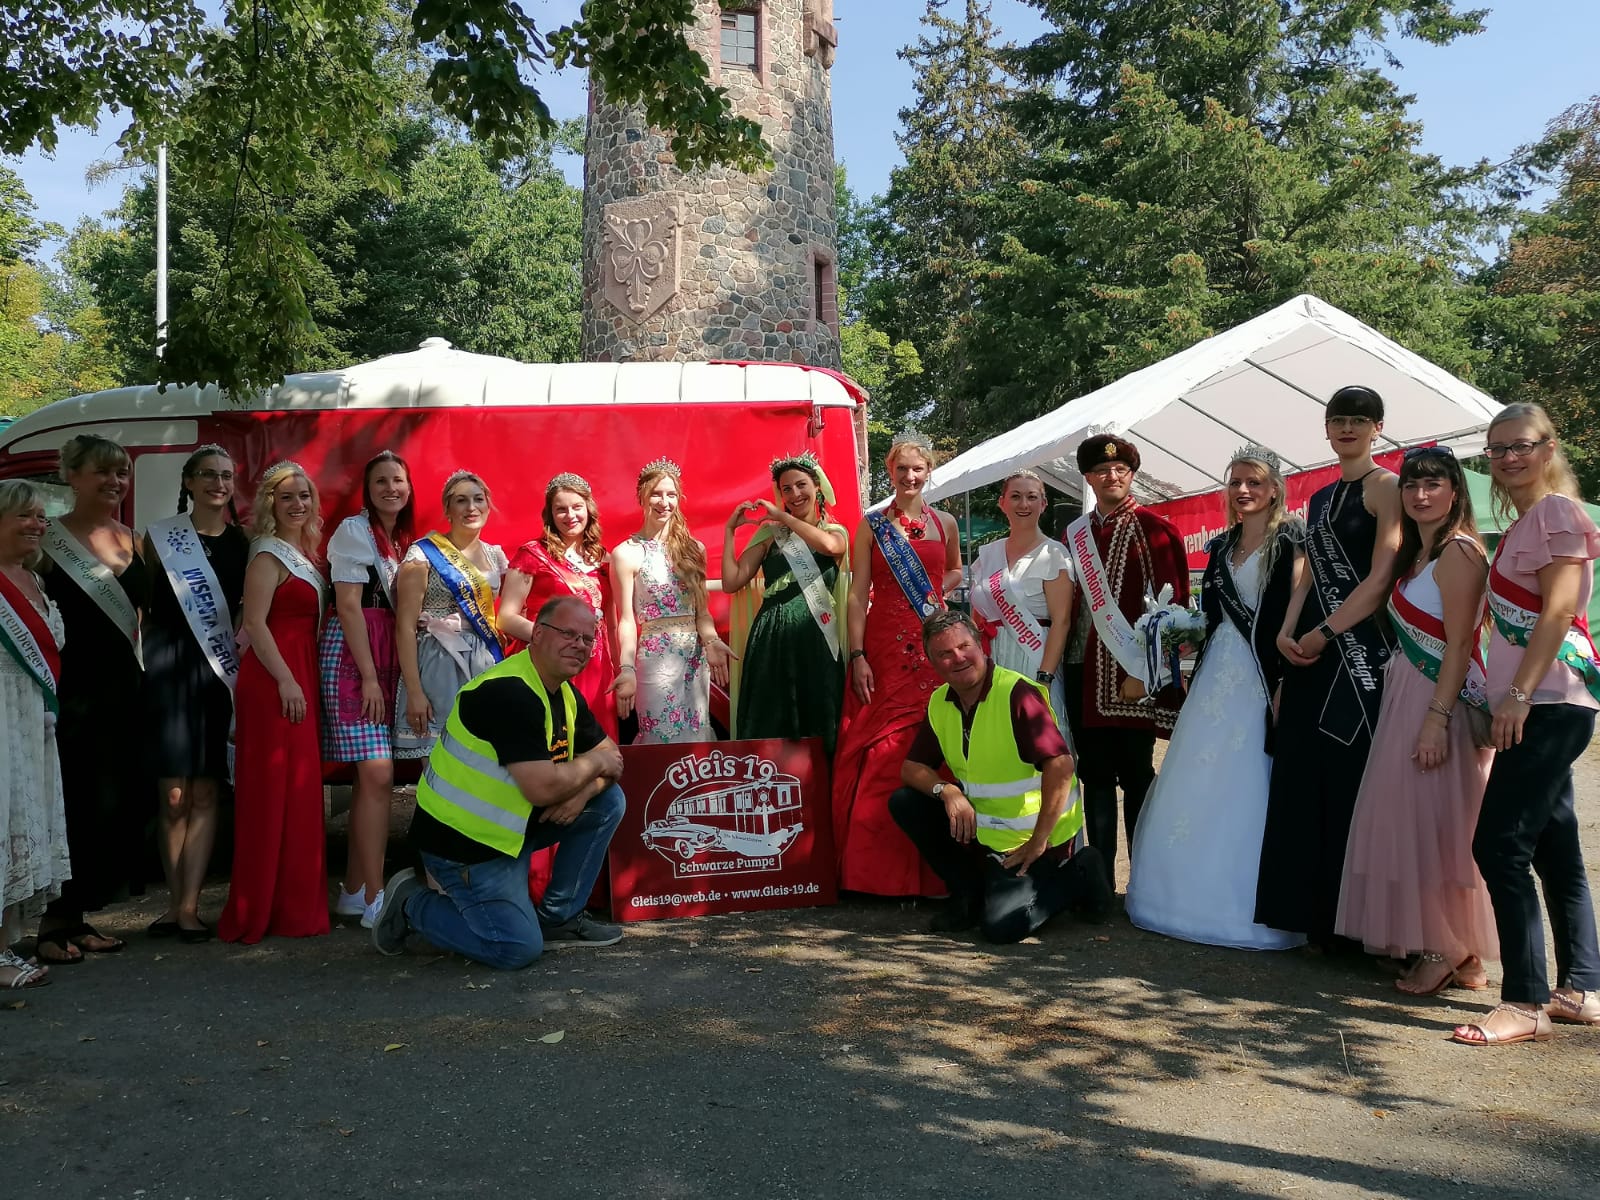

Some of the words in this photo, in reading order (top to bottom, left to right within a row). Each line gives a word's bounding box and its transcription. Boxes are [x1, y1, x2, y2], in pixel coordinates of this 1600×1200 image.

[1073, 525, 1107, 612] Wendenkönig
[1331, 559, 1352, 582] der
[457, 579, 478, 617] Sabrina
[988, 569, 1042, 652] Wendenkönigin
[0, 605, 44, 670] premberger
[207, 632, 240, 677] PERLE
[667, 752, 736, 790] Gleis
[742, 757, 775, 783] 19
[679, 860, 735, 874] Schwarze
[736, 856, 775, 871] Pumpe
[631, 890, 721, 908] Gleis19@web.de
[731, 882, 820, 899] www.Gleis-19.de
